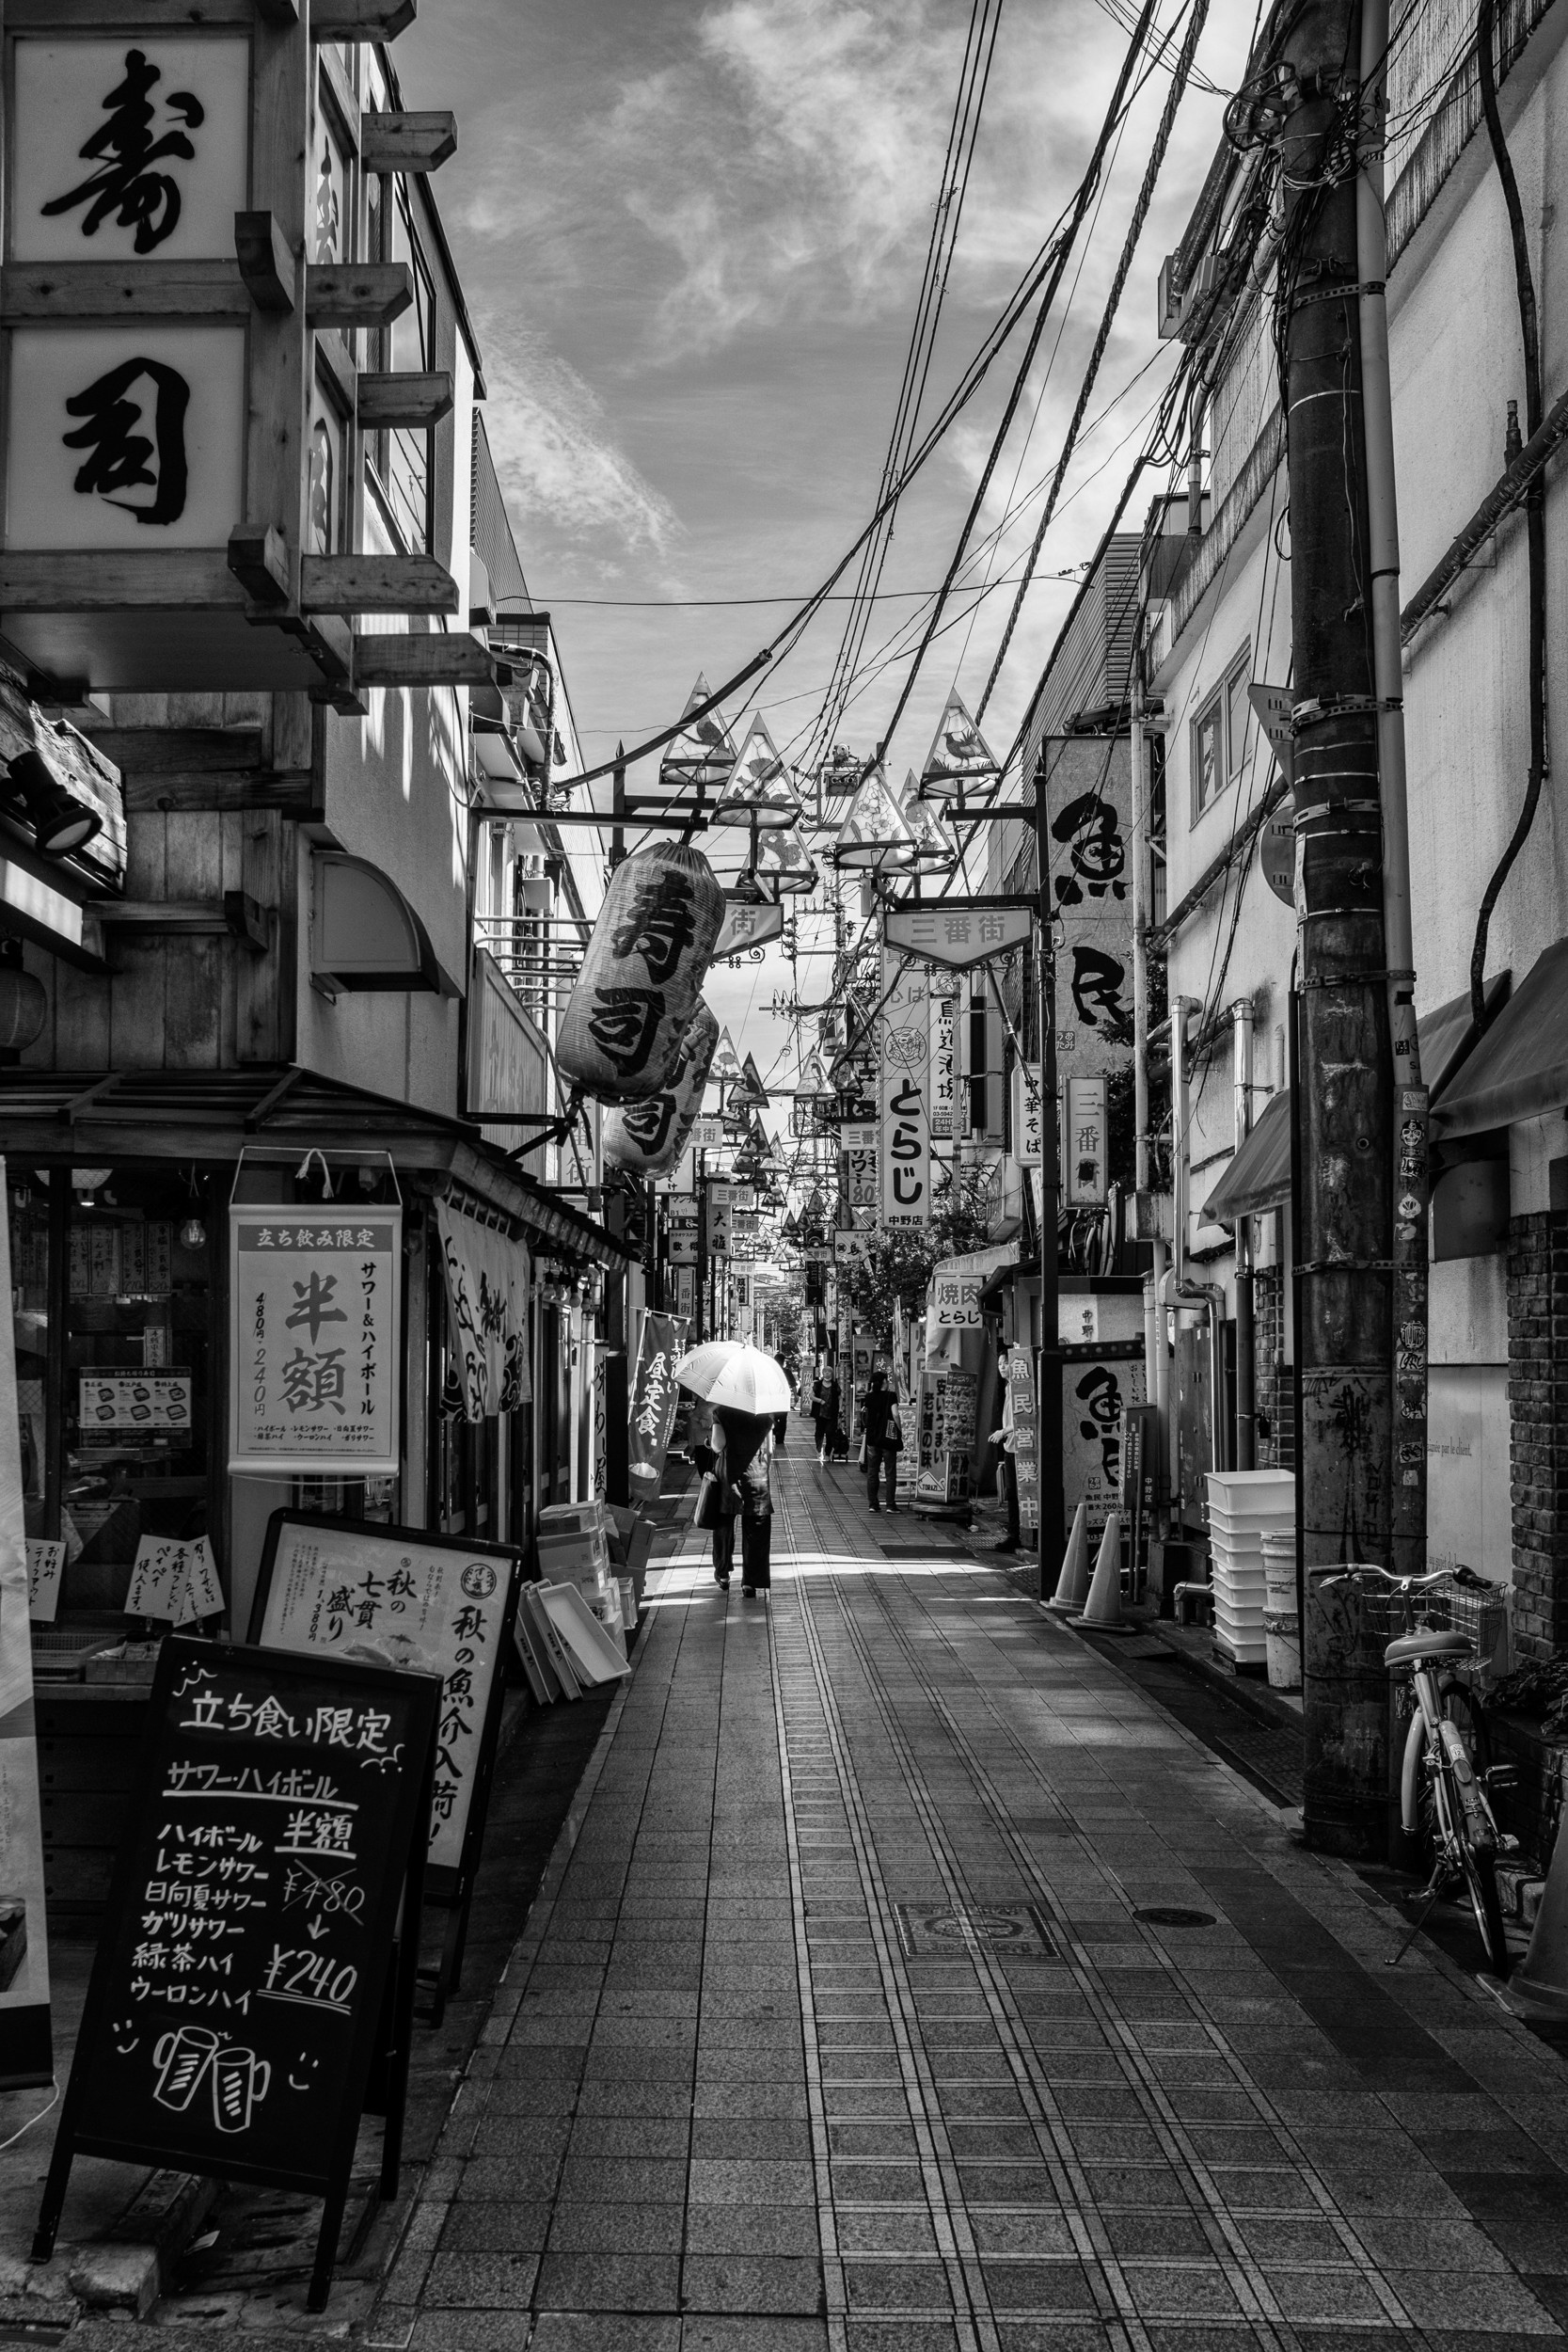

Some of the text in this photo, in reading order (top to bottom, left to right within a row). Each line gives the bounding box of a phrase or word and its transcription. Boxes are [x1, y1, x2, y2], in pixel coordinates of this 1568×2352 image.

[1051, 792, 1132, 1025] 魚民
[911, 915, 1006, 944] 三番街
[848, 1131, 880, 1145] 三番
[890, 1078, 923, 1205] とらじ
[717, 1189, 749, 1201] 三番街
[256, 1228, 376, 1248] 立ち飲み限定
[889, 1215, 924, 1226] 中野店
[680, 1273, 690, 1315] 三番街
[938, 1282, 981, 1306] 焼肉
[254, 1292, 265, 1338] 480円
[938, 1311, 980, 1326] とらじ
[1082, 1309, 1093, 1343] 中野
[277, 1269, 349, 1416] 半額
[254, 1348, 266, 1417] 240円
[636, 1351, 669, 1437] 昼定食
[1009, 1359, 1039, 1518] 魚民営業中
[1145, 1477, 1153, 1502] 中野区
[354, 1570, 386, 1629] 七貫
[387, 1568, 418, 1613] 秋の
[325, 1585, 356, 1642] 盛り
[180, 1691, 391, 1753] 立ち食い限定
[157, 1823, 263, 1853] ハイボール
[283, 1809, 354, 1851] 半額
[155, 1849, 269, 1883] レモンサワー
[145, 1881, 267, 1912] 日向夏サワー
[141, 1909, 245, 1940] ガリサワー
[132, 1942, 234, 1976] 緑茶ハイ
[130, 1976, 252, 2016] ウーロンハイ
